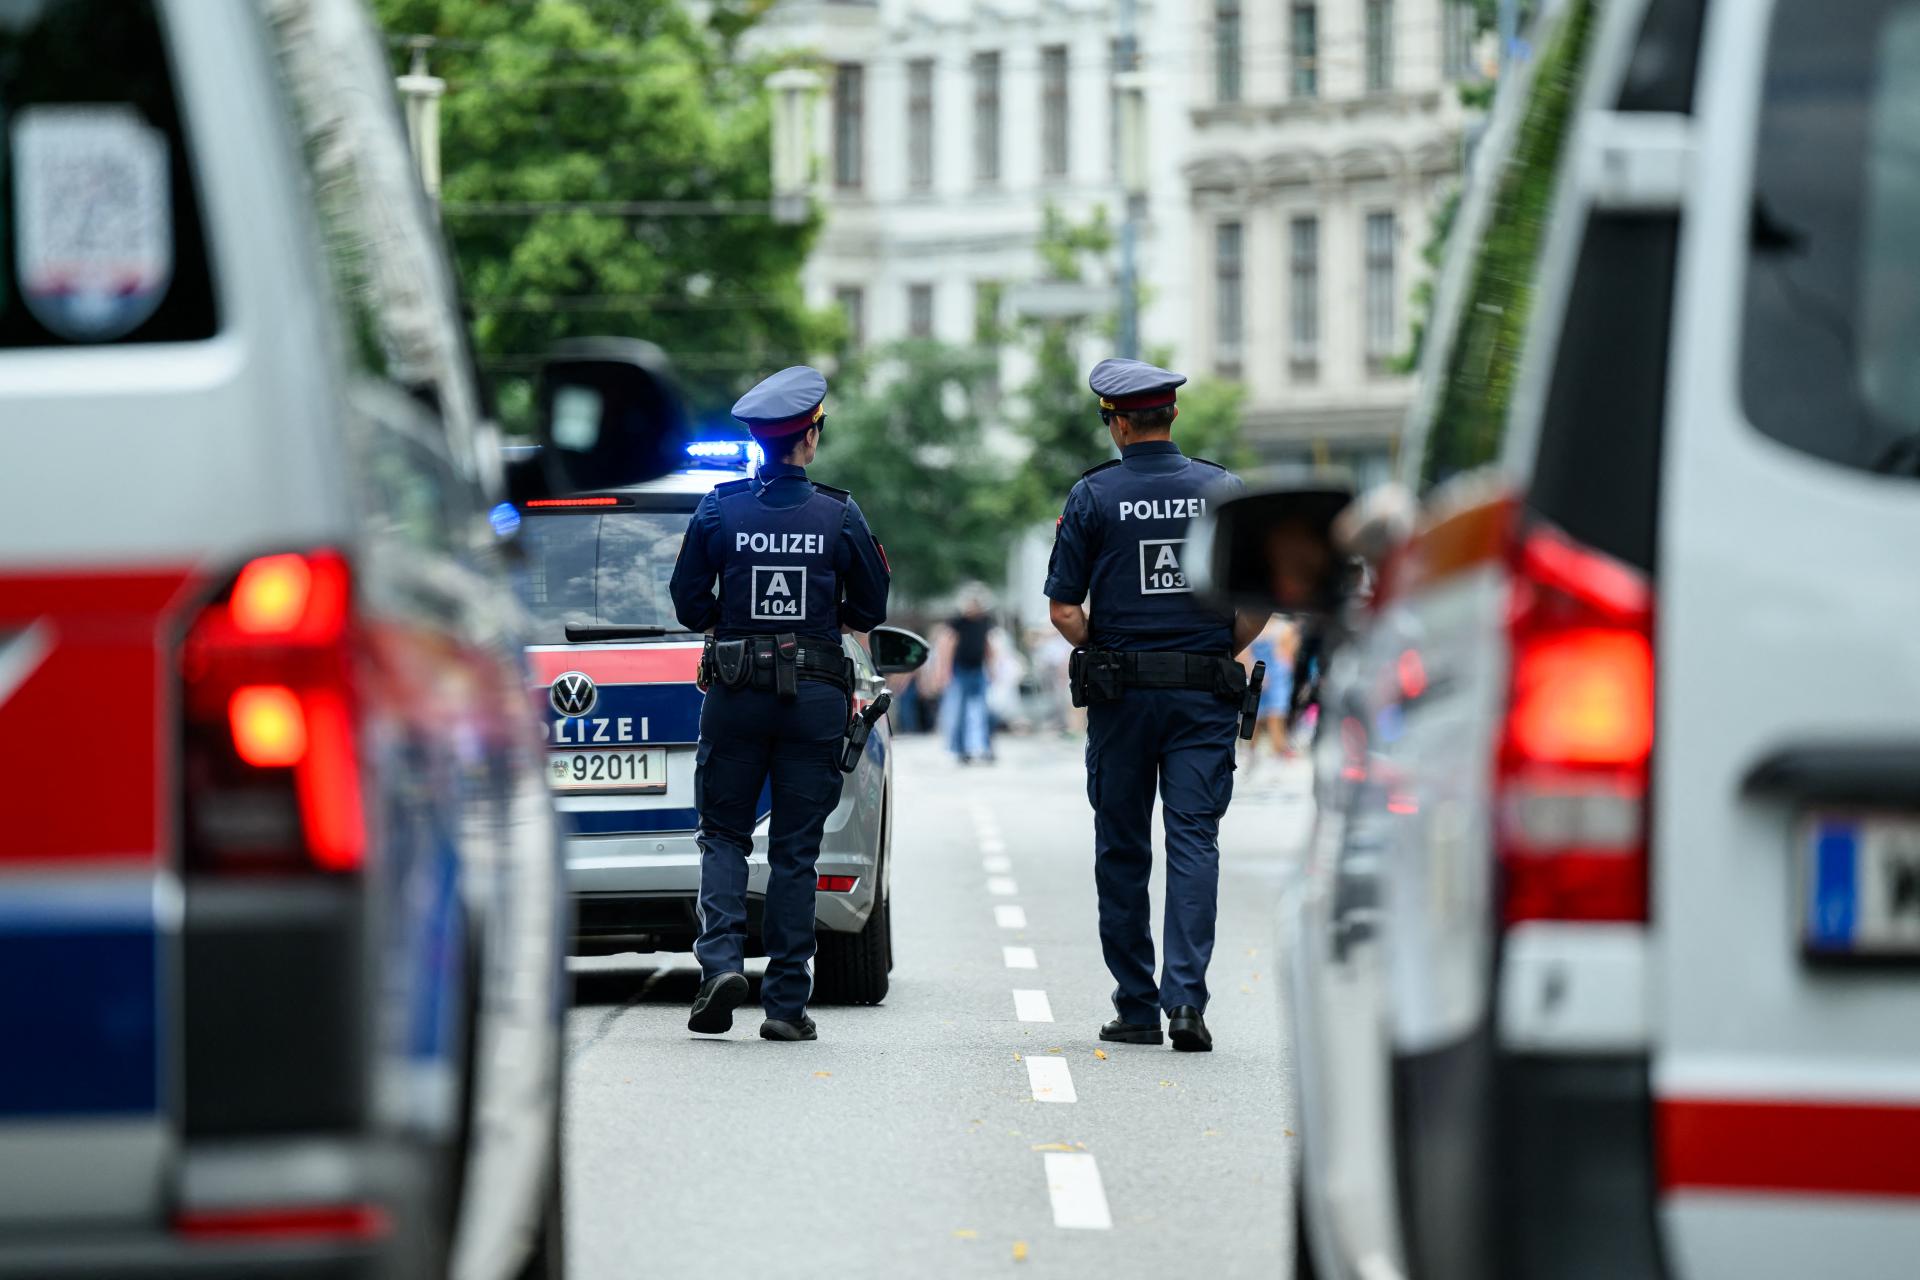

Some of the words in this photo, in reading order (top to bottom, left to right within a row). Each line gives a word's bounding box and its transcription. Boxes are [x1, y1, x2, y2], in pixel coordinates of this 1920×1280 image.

[1119, 498, 1206, 521] POLIZEI
[736, 532, 824, 554] POLIZEI
[1154, 545, 1179, 569] A
[765, 572, 791, 596] A
[1149, 572, 1186, 588] 103
[760, 600, 797, 614] 104
[553, 673, 594, 712] VW
[572, 753, 648, 781] 92011
